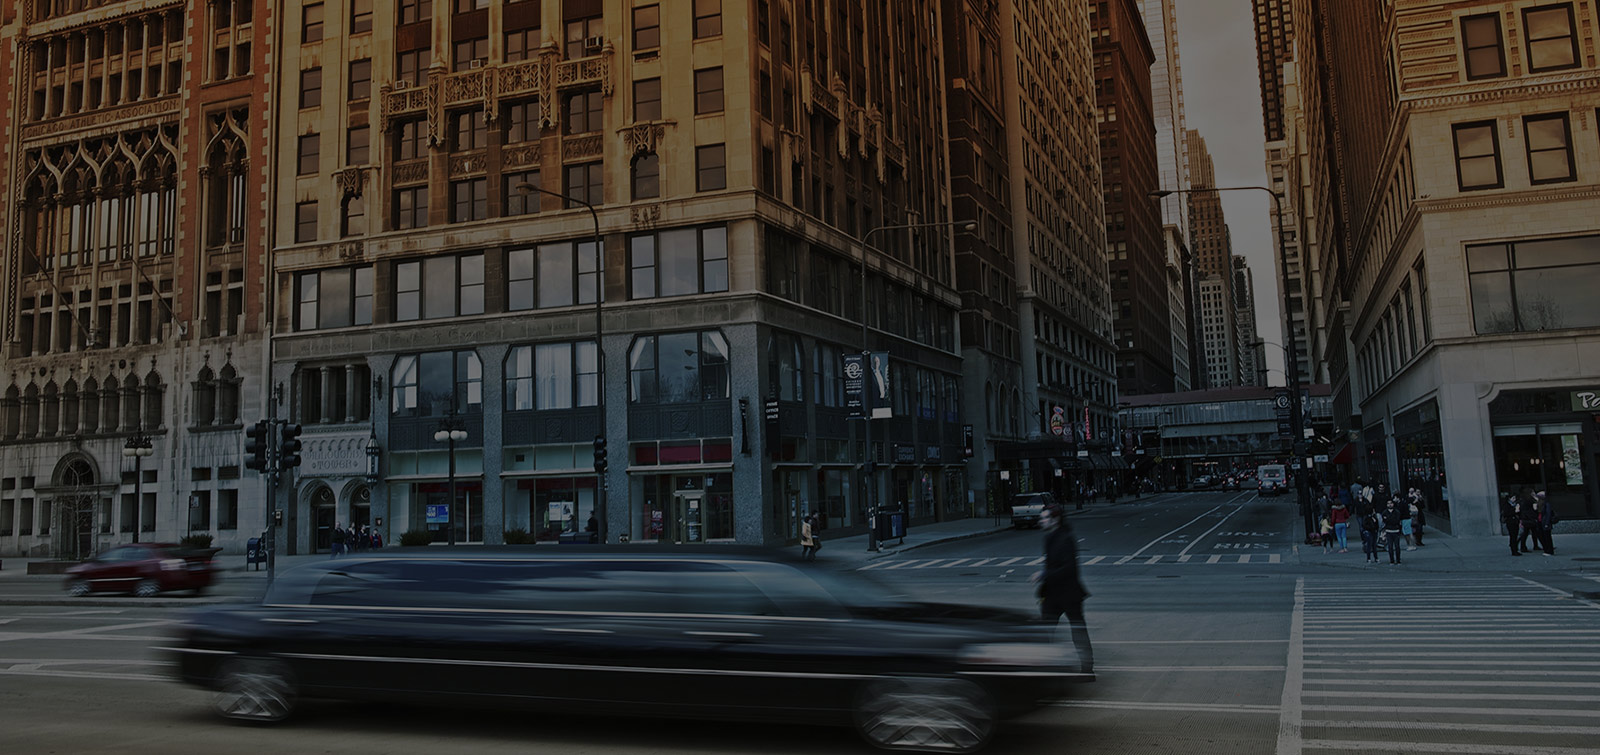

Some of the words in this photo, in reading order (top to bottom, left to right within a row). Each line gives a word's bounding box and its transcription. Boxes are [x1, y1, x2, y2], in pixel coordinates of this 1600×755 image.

[27, 123, 66, 138] CHICAGO
[70, 112, 111, 129] ATHLETIC
[115, 99, 178, 120] ASSOCIATION
[304, 449, 366, 460] WILLOUGHBY
[317, 460, 352, 469] TOWER
